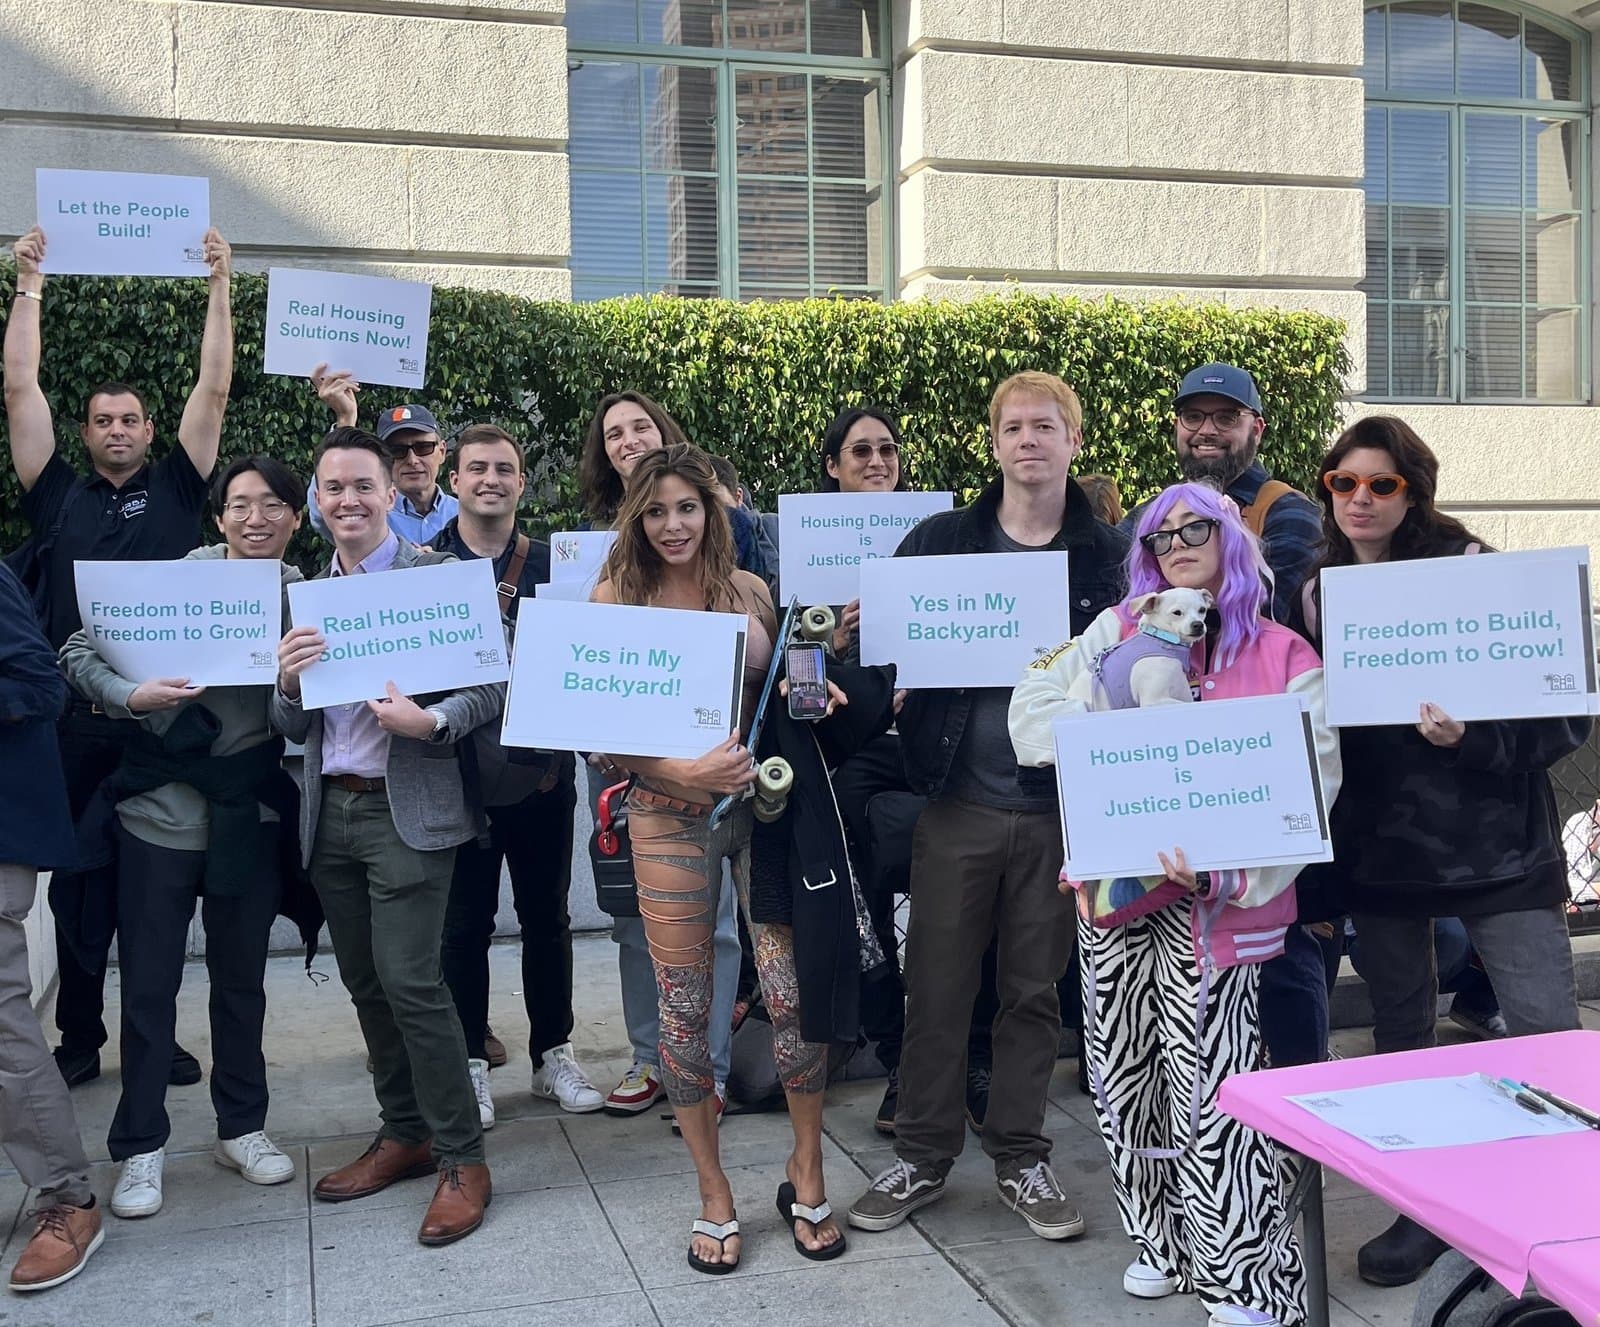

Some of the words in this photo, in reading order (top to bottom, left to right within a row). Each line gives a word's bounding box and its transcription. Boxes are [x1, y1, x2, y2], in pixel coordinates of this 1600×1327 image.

[59, 200, 86, 214] Let
[93, 201, 120, 215] the
[128, 203, 189, 220] People
[98, 223, 150, 238] Build!
[289, 300, 324, 317] Real
[331, 304, 404, 329] Housing
[280, 322, 359, 342] Solutions
[366, 330, 410, 349] Now!
[801, 515, 864, 531] Housing
[869, 514, 930, 530] Delaye
[859, 534, 872, 547] is
[807, 552, 861, 567] Justice
[92, 602, 176, 617] Freedom
[184, 602, 203, 616] to
[211, 600, 265, 617] Build,
[910, 595, 948, 612] Yes
[958, 594, 976, 611] in
[985, 593, 1016, 614] My
[324, 612, 371, 634] Real
[379, 602, 470, 626] Housing
[1344, 620, 1446, 640] Freedom
[1456, 618, 1479, 633] to
[1489, 610, 1560, 631] Build,
[93, 624, 176, 641] Freedom
[184, 626, 202, 640] to
[210, 624, 266, 639] Grow!
[429, 624, 483, 647] Now!
[908, 620, 1019, 643] Backyard!
[571, 644, 610, 663] Yes
[620, 647, 638, 665] in
[648, 649, 681, 672] My
[1344, 648, 1446, 668] Freedom
[1456, 646, 1479, 662] to
[1488, 638, 1563, 660] Grow!
[564, 672, 680, 698] Backyard!
[1090, 744, 1178, 765] Housing
[1186, 732, 1271, 756] Delayed
[1174, 768, 1192, 783] is
[1105, 796, 1180, 816] Justice
[1188, 785, 1270, 808] Denied!
